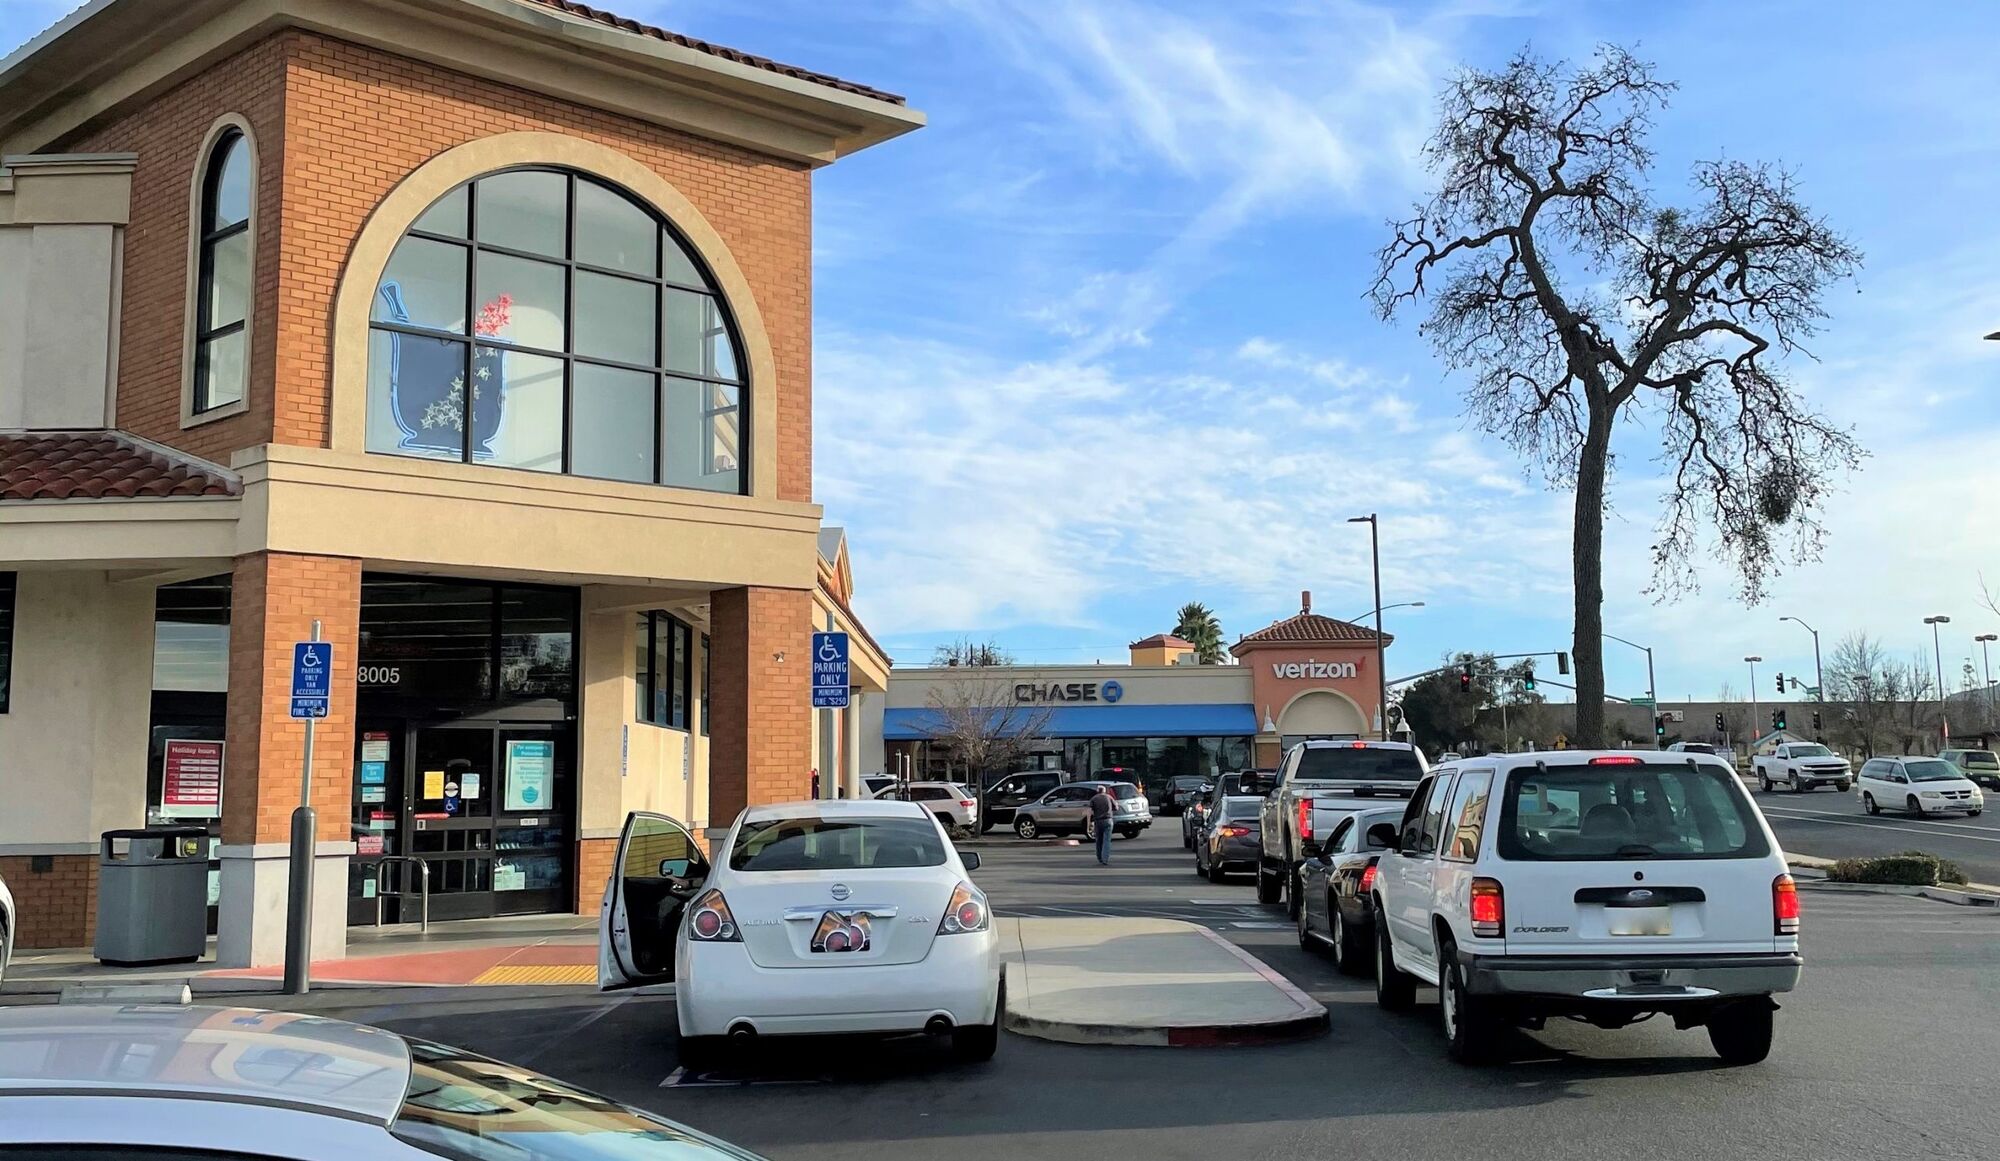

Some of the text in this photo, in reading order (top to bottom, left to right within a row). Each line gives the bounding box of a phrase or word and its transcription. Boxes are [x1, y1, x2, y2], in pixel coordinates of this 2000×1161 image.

[814, 662, 847, 673] PARKING
[1272, 658, 1356, 678] verizon
[357, 666, 400, 683] 8005
[820, 674, 840, 685] ONLY
[818, 688, 843, 696] MINIMUM
[1015, 683, 1097, 701] CHASE
[297, 699, 322, 707] MINIMUM
[814, 697, 827, 705] FINE
[171, 746, 197, 754] Holiday
